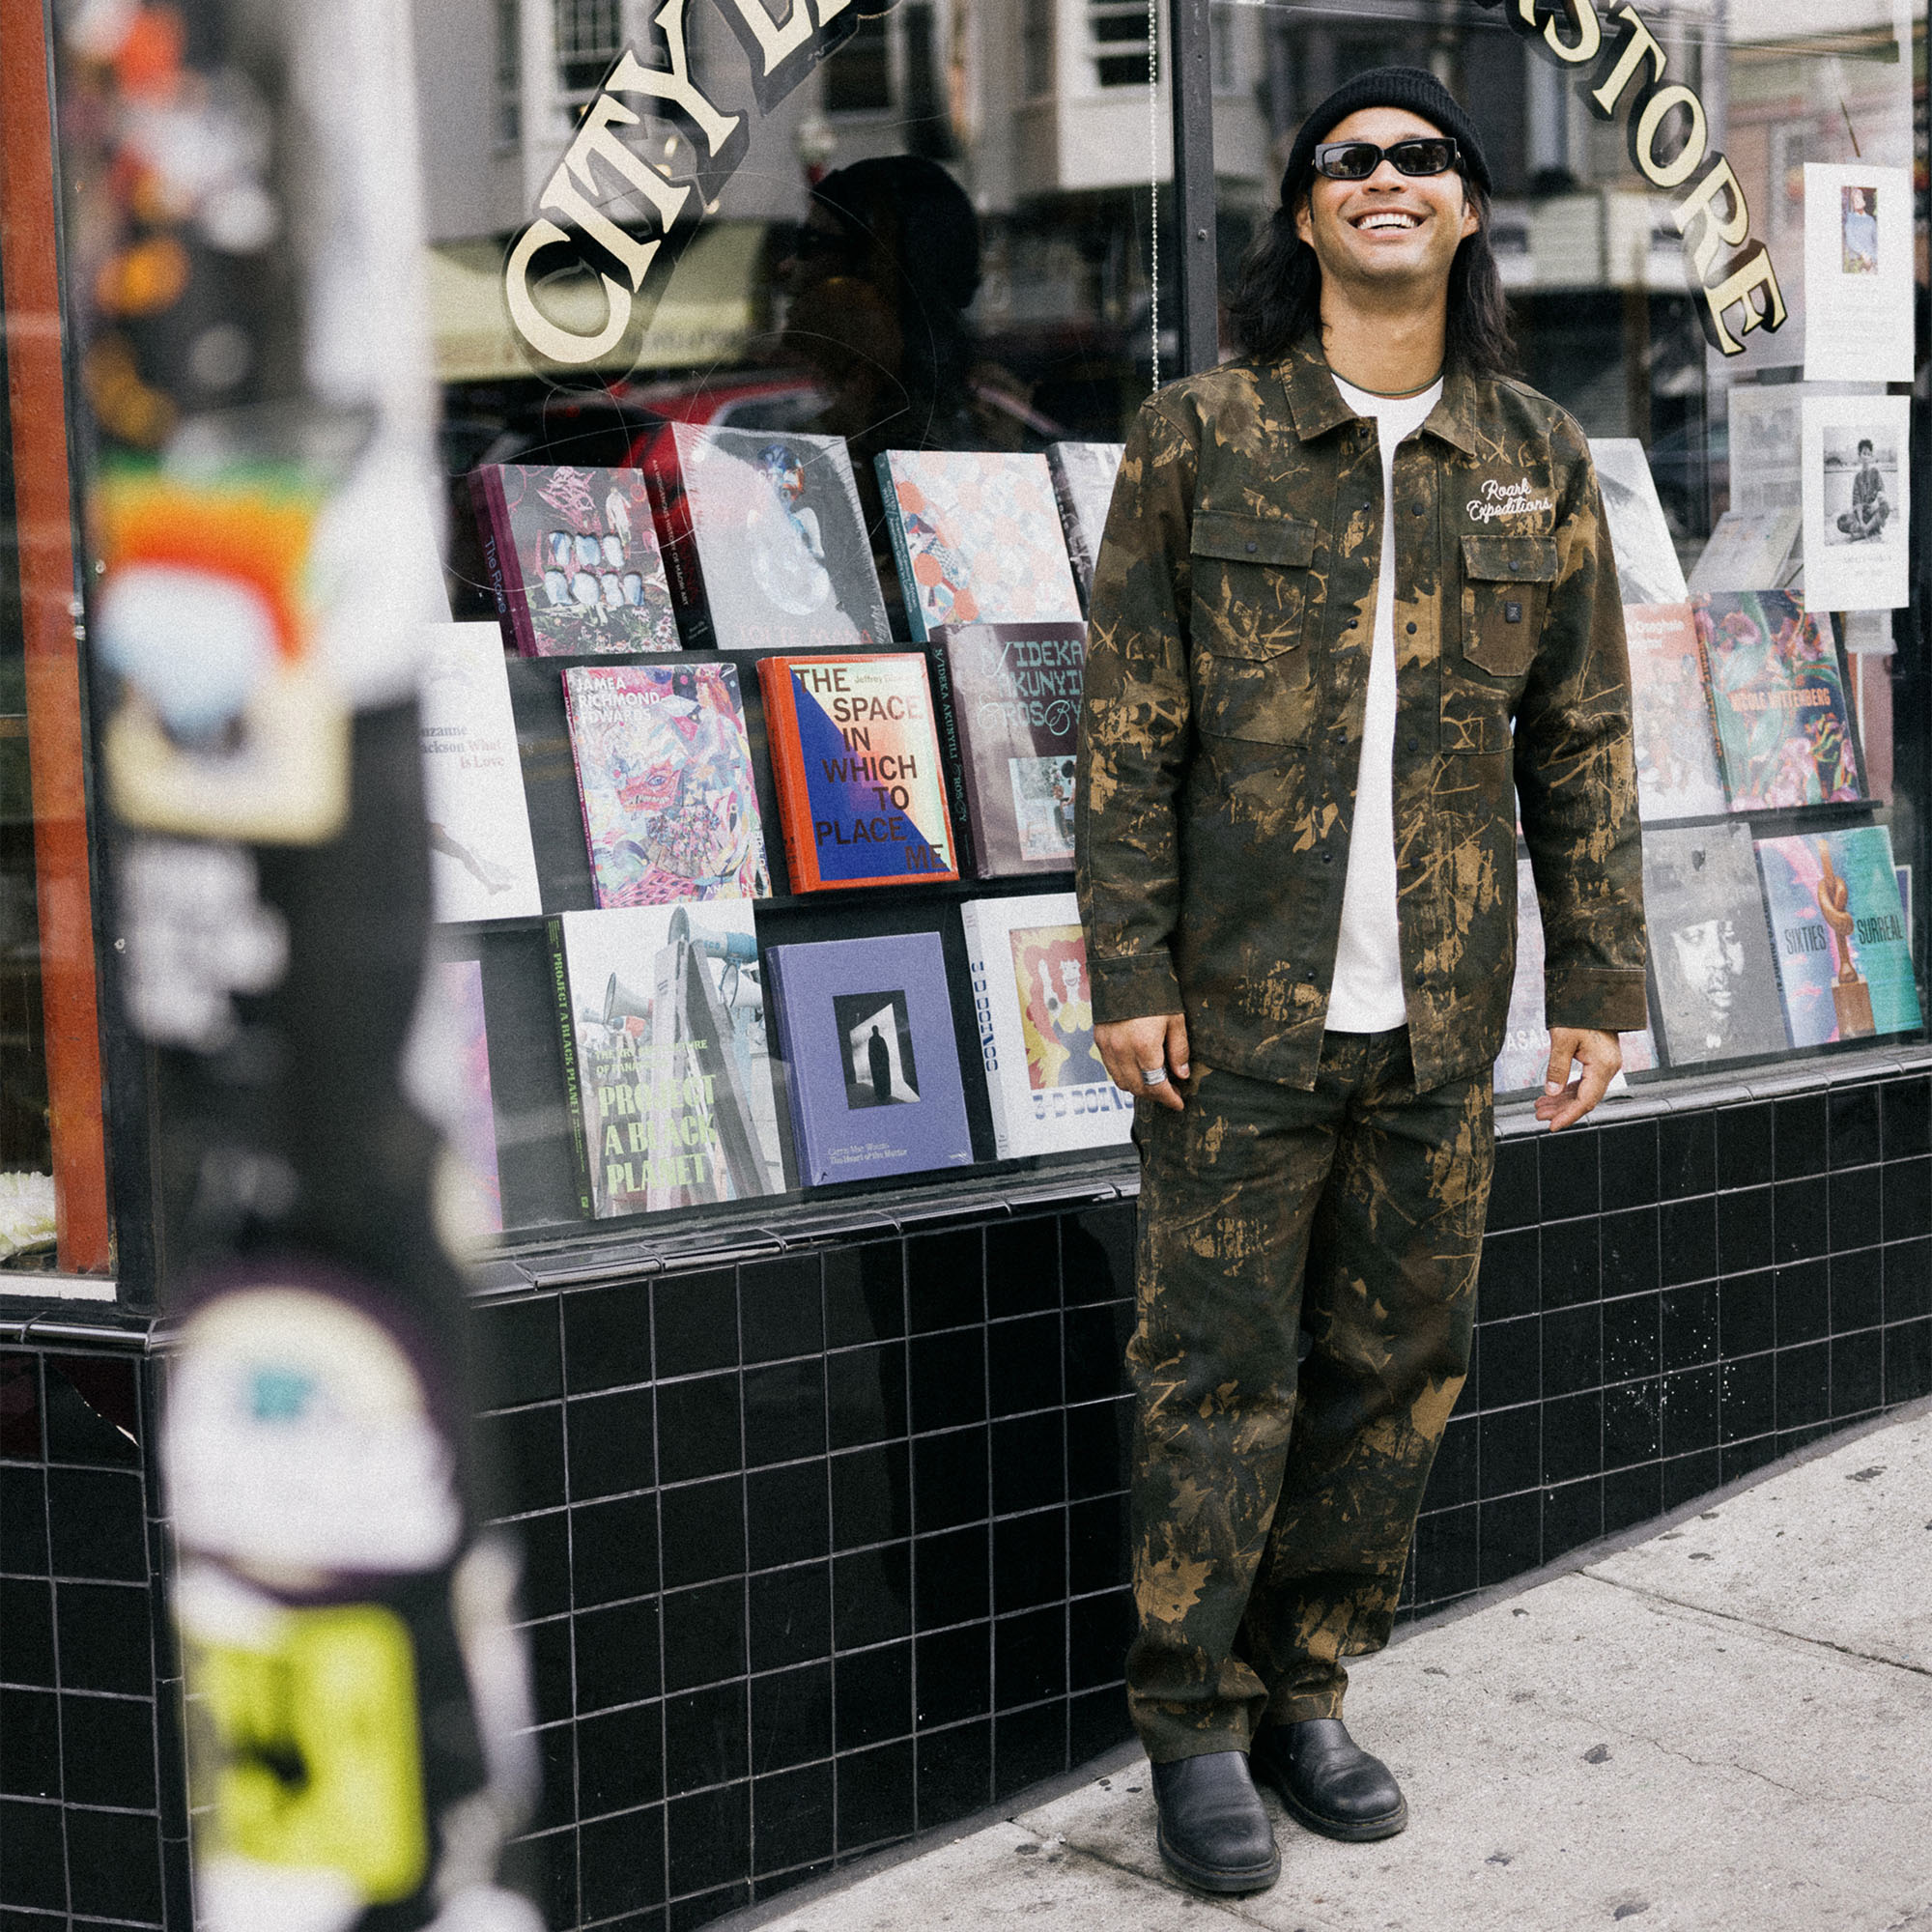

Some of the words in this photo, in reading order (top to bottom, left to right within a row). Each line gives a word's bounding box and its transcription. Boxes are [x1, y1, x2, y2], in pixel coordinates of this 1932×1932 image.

[506, 0, 739, 363] CITY
[1520, 0, 1787, 355] STORE
[1481, 478, 1531, 500] Roark
[1466, 497, 1552, 524] Expeditions
[484, 535, 497, 568] The
[792, 668, 850, 693] THE
[997, 669, 1084, 699] AKUNYI
[833, 695, 923, 723] SPACE
[1730, 691, 1767, 712] NICOLE
[1767, 688, 1831, 709] WITTENBERG
[420, 726, 467, 737] uzanne
[842, 726, 871, 753] IN
[943, 702, 957, 758] AKUNYILI
[422, 741, 465, 753] ackson
[473, 756, 504, 768] Love
[821, 754, 918, 783] WHICH
[872, 785, 910, 812] TO
[814, 816, 907, 846] PLACE
[904, 844, 948, 870] ME
[1784, 924, 1827, 954] SIXTIES
[1856, 915, 1904, 945] SURREAL
[553, 952, 567, 1008] PROJECT
[559, 1011, 569, 1021] A
[560, 1023, 574, 1065] BLACK
[565, 1067, 580, 1114] PLANET
[597, 1074, 717, 1117] PROJECT
[1032, 1094, 1067, 1120] 3-D
[604, 1124, 624, 1156] A
[627, 1113, 717, 1153] BLACK
[607, 1152, 707, 1195] PLANET
